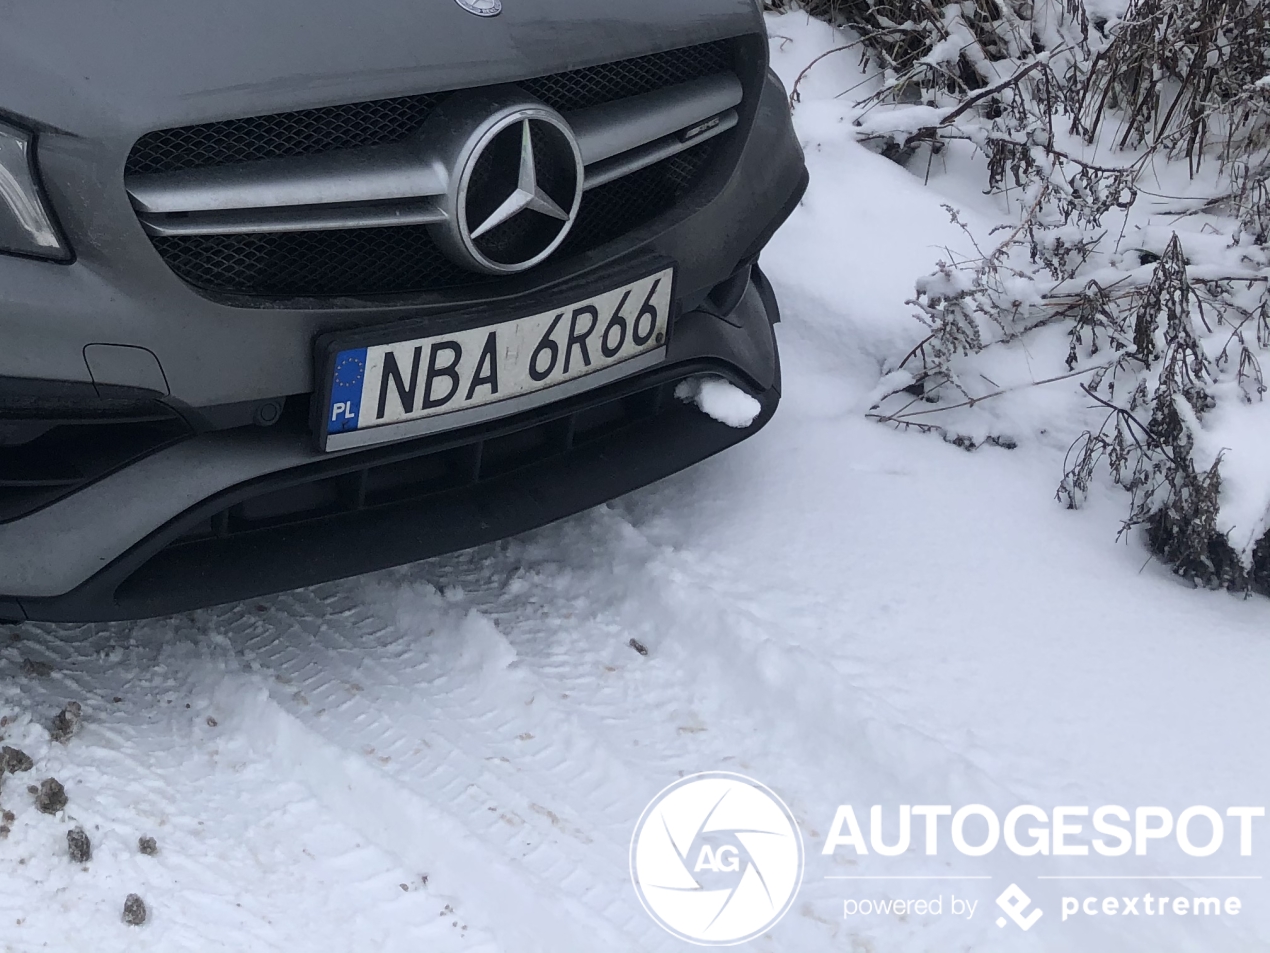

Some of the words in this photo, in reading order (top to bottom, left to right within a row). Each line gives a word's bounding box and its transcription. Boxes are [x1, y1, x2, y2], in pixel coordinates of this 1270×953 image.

[376, 331, 499, 419] NBA
[529, 278, 661, 382] 6R66
[332, 402, 355, 421] PL
